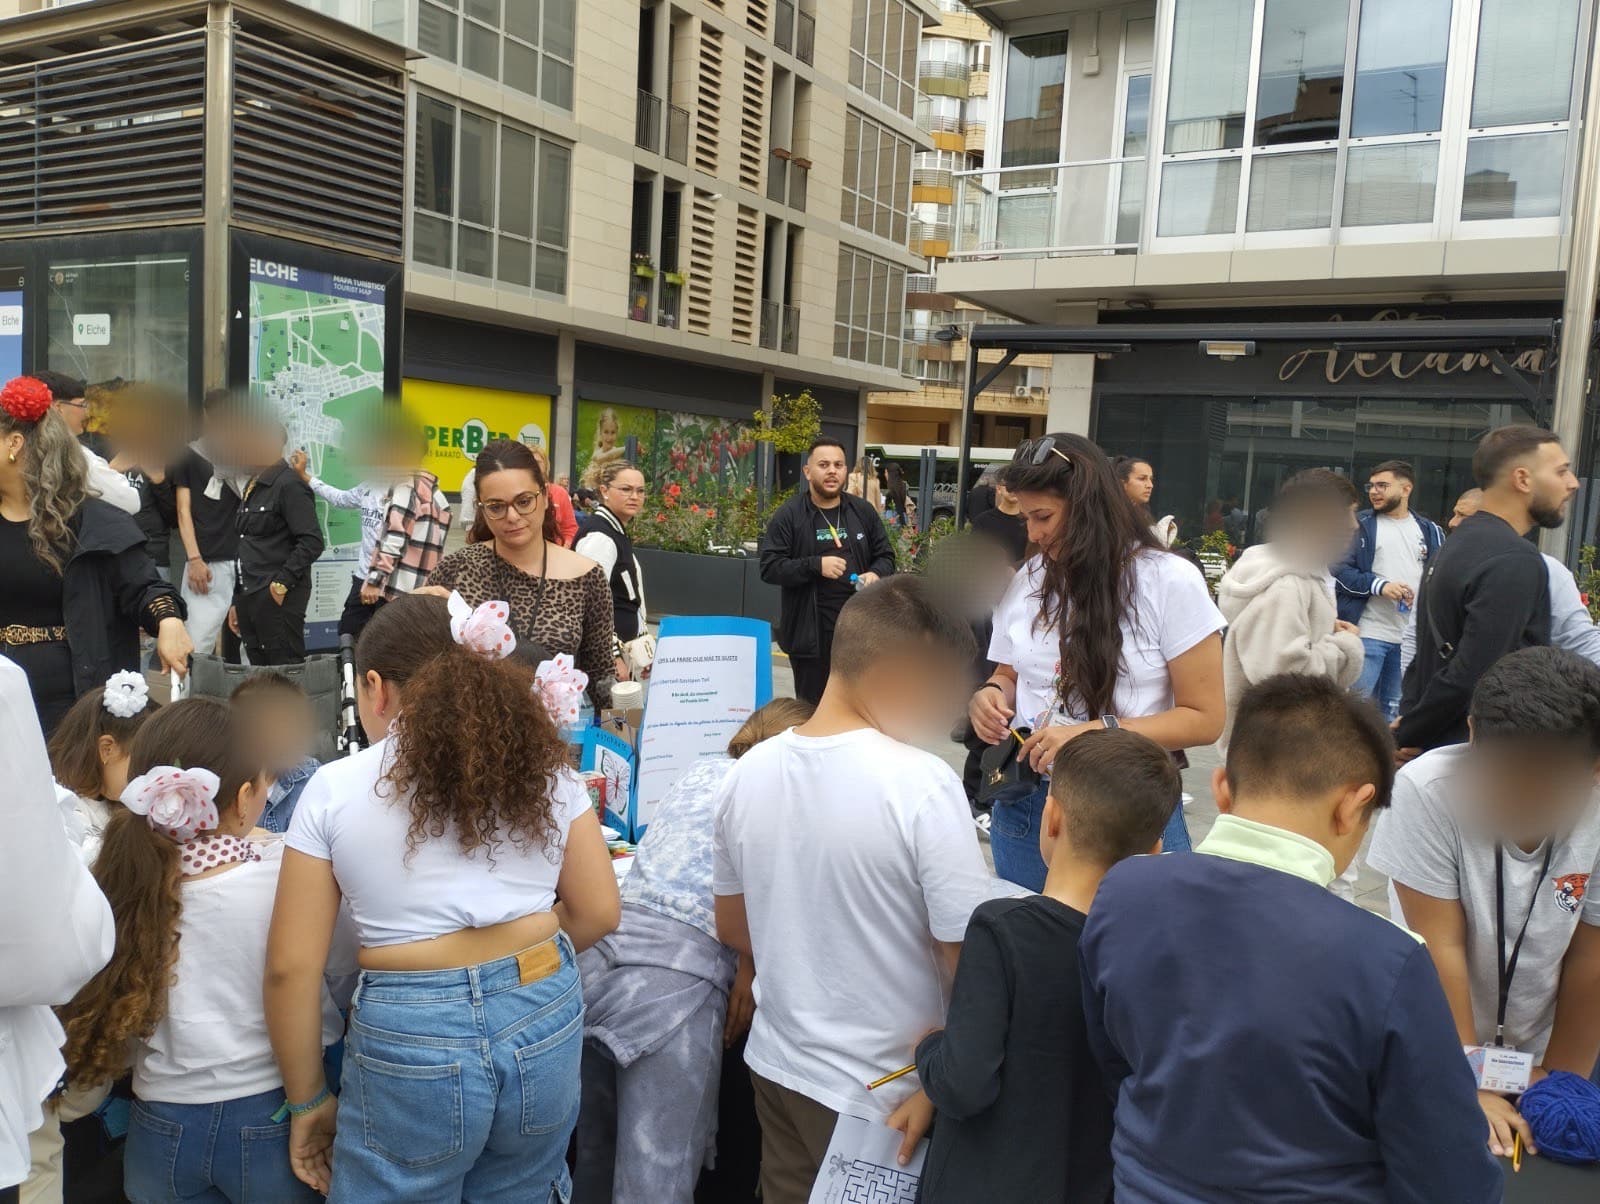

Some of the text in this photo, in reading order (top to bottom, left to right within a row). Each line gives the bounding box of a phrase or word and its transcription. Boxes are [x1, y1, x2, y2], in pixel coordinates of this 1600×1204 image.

[249, 257, 299, 282] ELCHE
[334, 283, 358, 294] TOURIST
[86, 324, 106, 335] Elche
